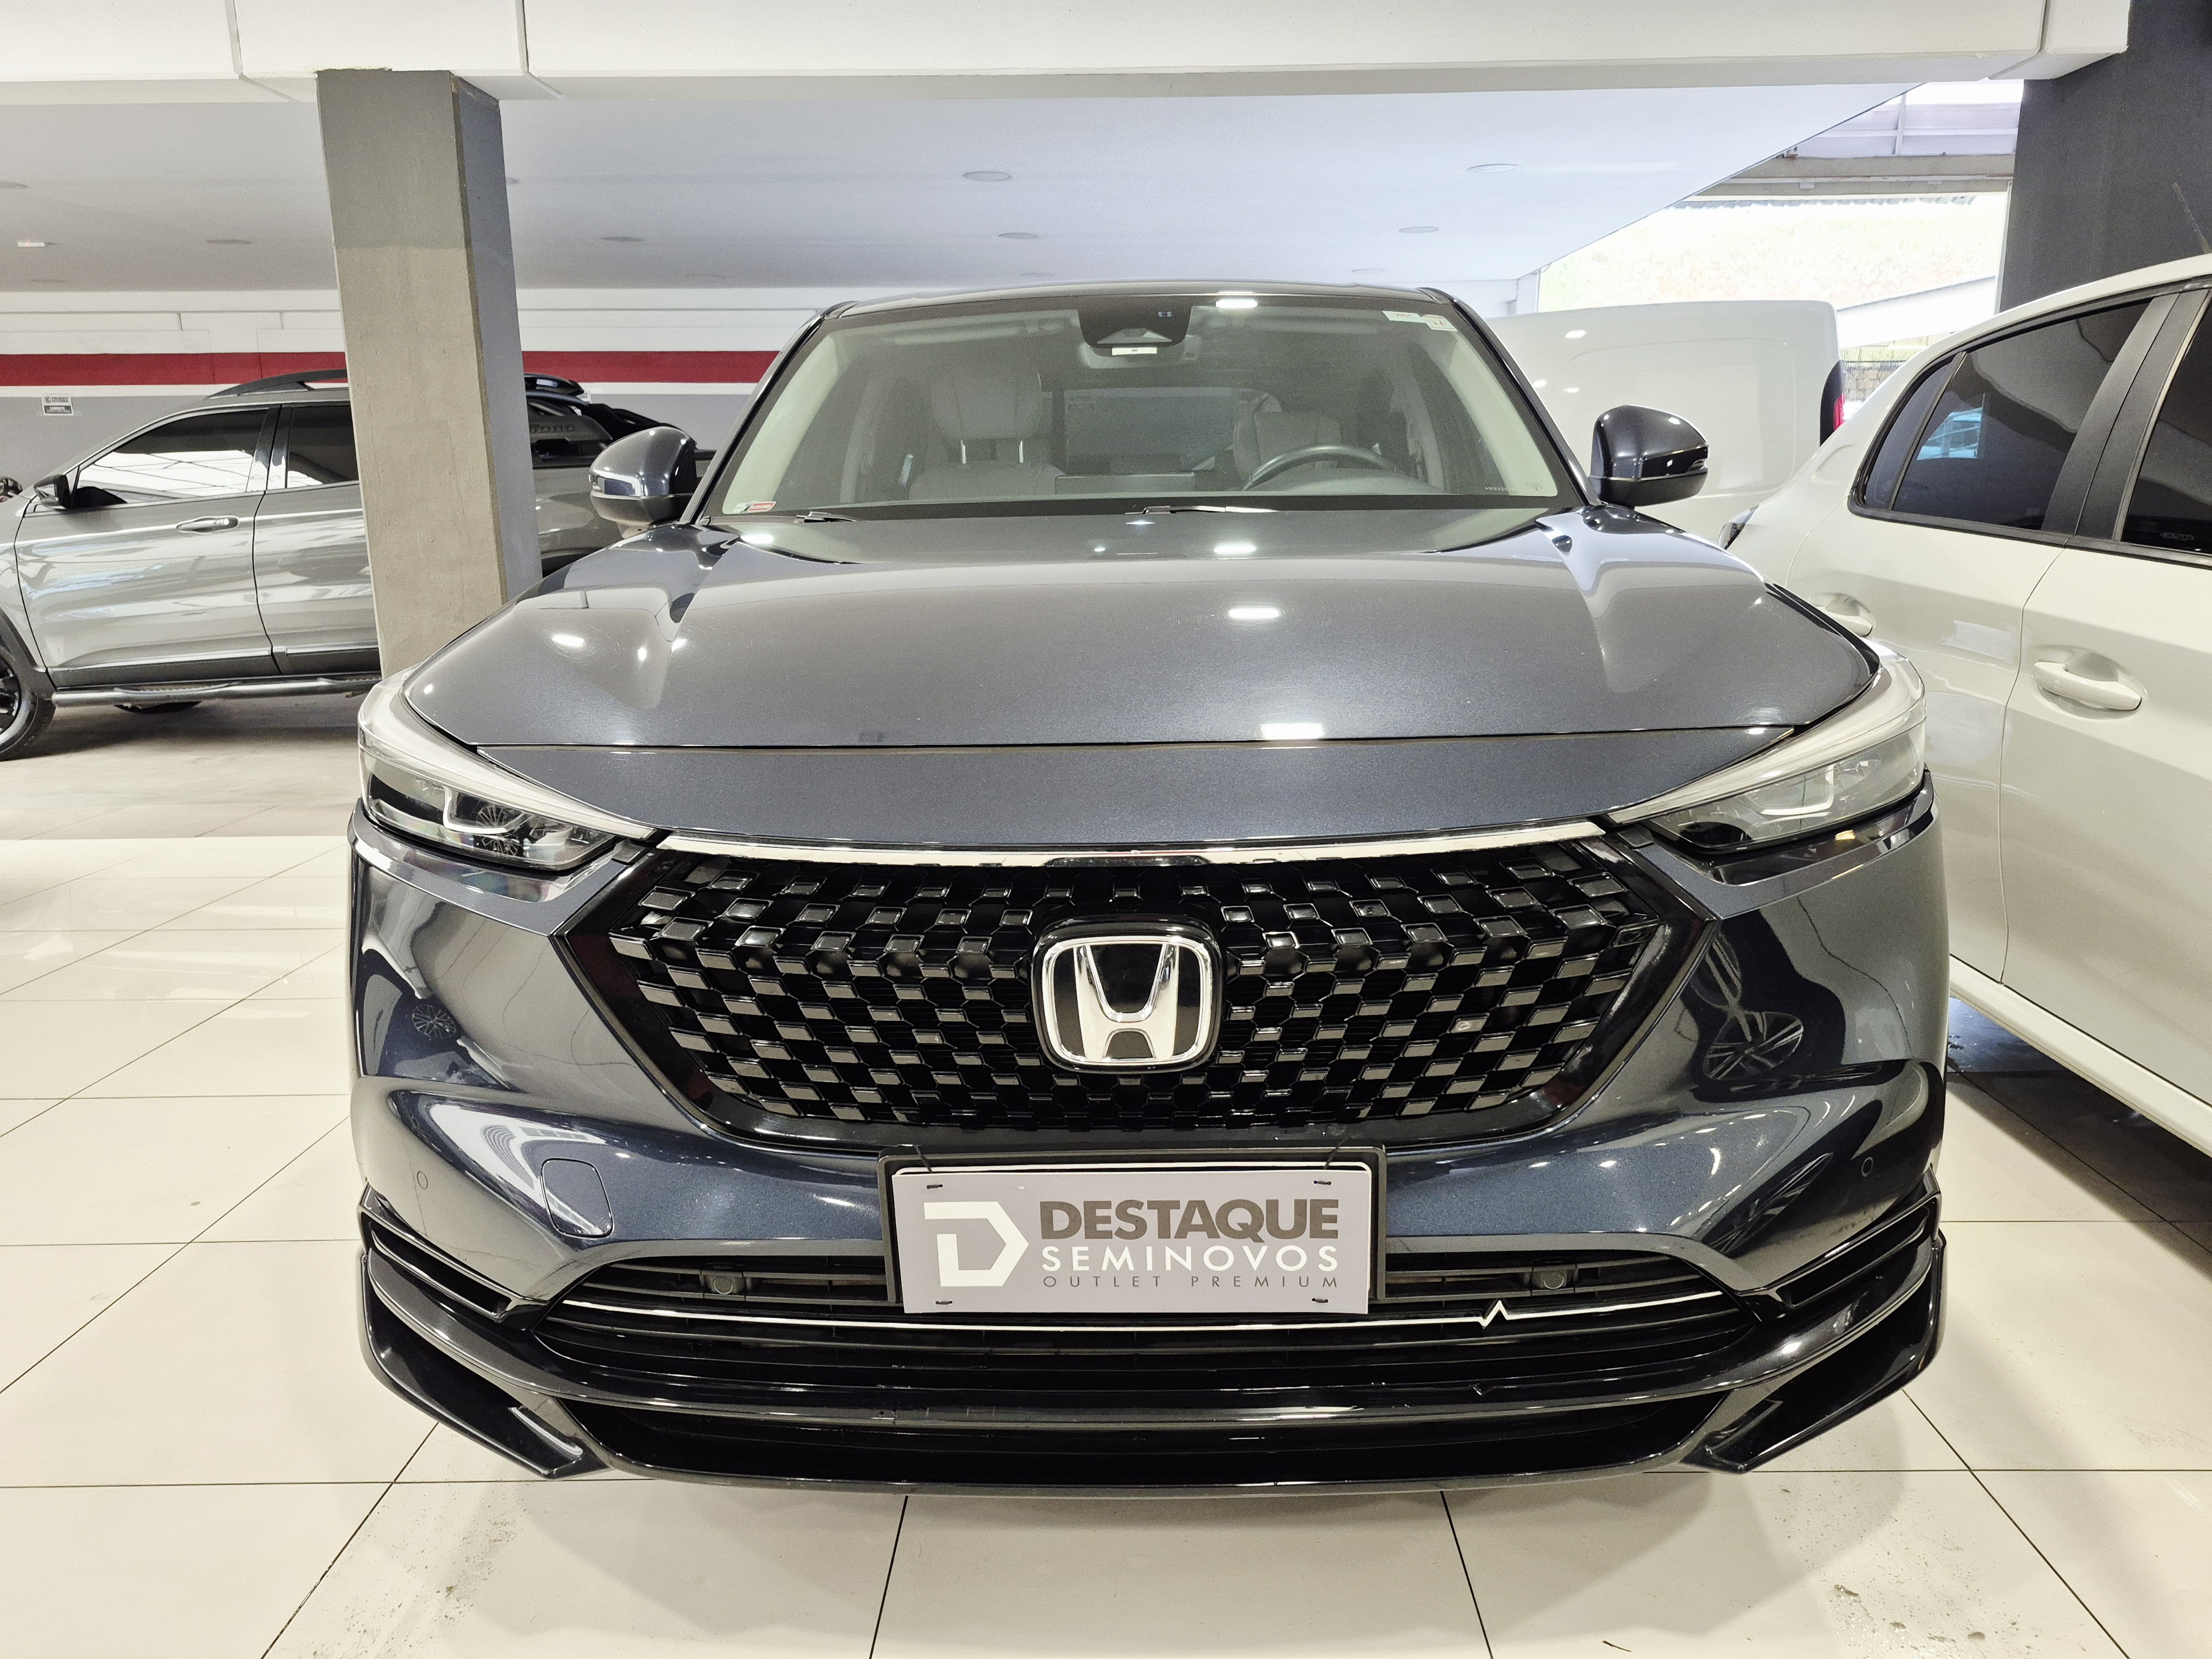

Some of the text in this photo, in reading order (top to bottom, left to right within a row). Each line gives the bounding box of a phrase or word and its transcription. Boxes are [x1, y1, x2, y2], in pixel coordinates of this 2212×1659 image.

[1040, 1199, 1339, 1243] DESTAQUE
[1042, 1245, 1338, 1272] SEMINOVOS
[1043, 1276, 1337, 1287] OUTLET PREMIUM
